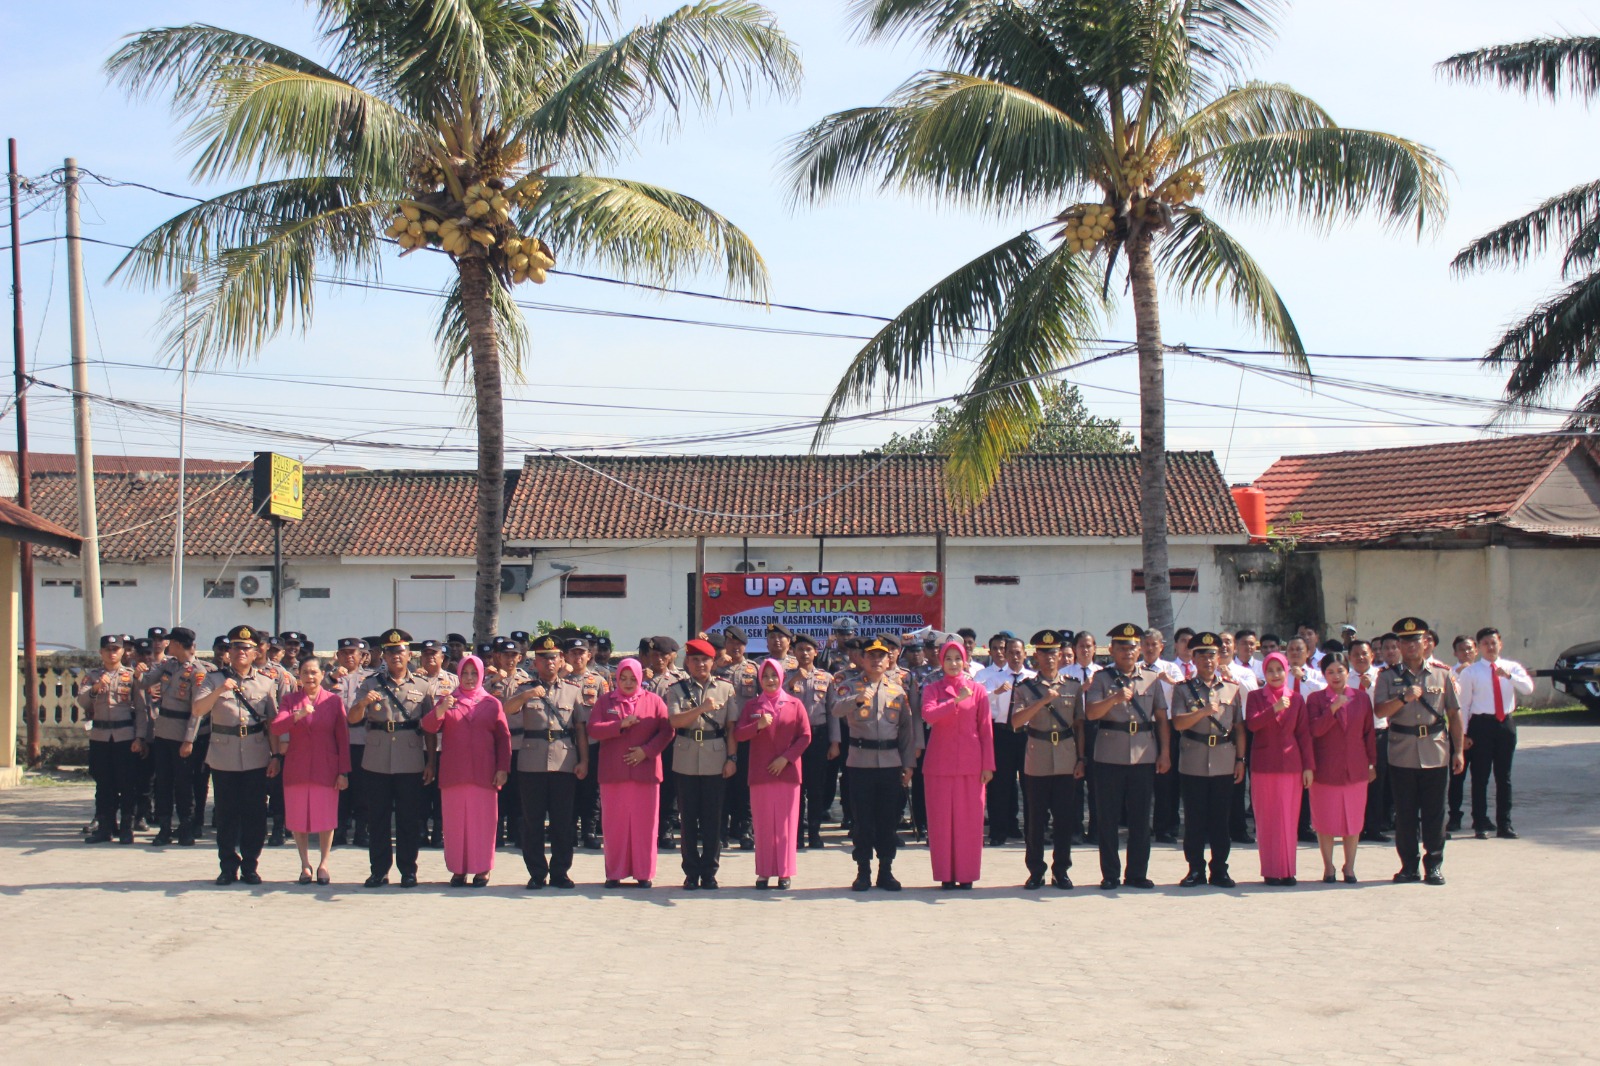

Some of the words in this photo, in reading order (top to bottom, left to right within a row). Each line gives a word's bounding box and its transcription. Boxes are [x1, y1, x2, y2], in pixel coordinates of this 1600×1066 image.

[273, 455, 290, 471] POLISI
[273, 470, 290, 485] POLICE
[745, 577, 899, 596] UPACARA
[773, 599, 871, 613] SERTIJAB
[721, 615, 731, 625] PS
[733, 615, 760, 625] KABAG
[863, 615, 873, 624] PS
[875, 615, 924, 625] KASIHUMAS,
